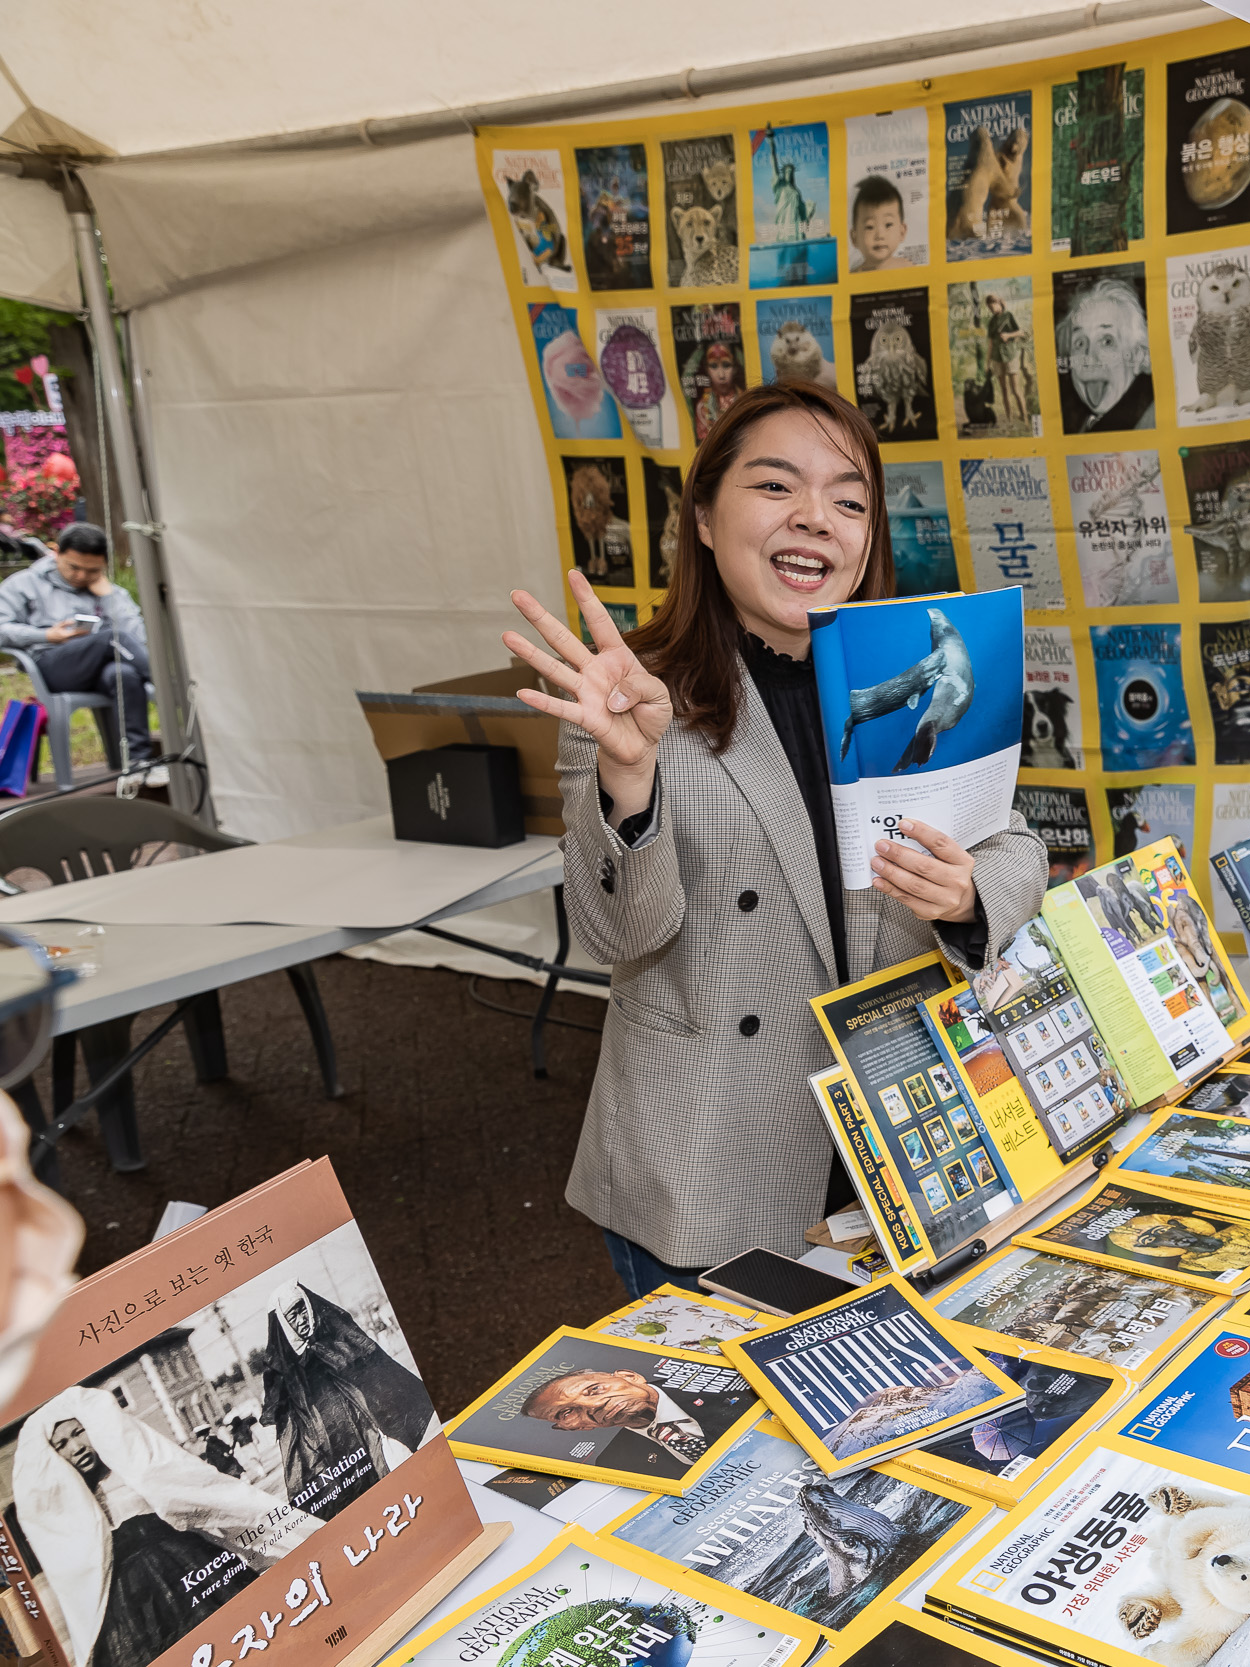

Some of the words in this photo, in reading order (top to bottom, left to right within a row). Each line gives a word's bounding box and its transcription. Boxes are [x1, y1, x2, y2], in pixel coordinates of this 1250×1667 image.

[1195, 70, 1236, 88] NATIONAL
[960, 100, 1017, 121] NATIONAL
[1181, 139, 1213, 163] 붉은
[1218, 133, 1250, 157] 행성
[1080, 166, 1121, 185] 레드우드
[966, 476, 1047, 500] GEOGRAPHIC
[977, 462, 1032, 485] NATIONAL
[1078, 516, 1127, 540] 유전자
[1131, 515, 1167, 537] 가위
[988, 522, 1038, 579] 물
[1053, 671, 1070, 683] 지능
[1018, 790, 1072, 806] NATIONAL
[1123, 791, 1181, 806] NATIONAL
[845, 1006, 885, 1030] SPECIAL
[881, 995, 917, 1016] EDITION
[913, 991, 925, 1003] 12
[856, 994, 887, 1011] NATIONAL
[884, 981, 921, 1000] GEOGRAPHIC
[832, 1089, 844, 1099] 3
[837, 1101, 856, 1129] PART
[973, 1118, 988, 1135] 20
[989, 1099, 1026, 1130] 내셔널
[850, 1129, 876, 1174] EDITION
[1001, 1122, 1038, 1153] 베스트
[1148, 1130, 1182, 1156] NATIONAL
[1153, 1127, 1198, 1162] GEOGRAPHIC
[870, 1173, 896, 1222] SPECIAL
[1037, 1211, 1098, 1240] 투탕카멘의
[1088, 1188, 1125, 1212] 보물들
[891, 1221, 908, 1250] KIDS
[1076, 1208, 1125, 1234] NATIONAL
[1081, 1206, 1144, 1240] GEOGRAPHIC
[76, 1289, 167, 1348] 사진으로
[172, 1263, 209, 1299] 보는
[213, 1247, 234, 1273] 옛
[238, 1224, 274, 1258] 한국
[967, 1266, 1020, 1299] NATIONAL
[972, 1265, 1039, 1308] GEOGRAPHIC
[789, 1308, 864, 1341] NATIONAL
[799, 1315, 826, 1328] PREPARED
[850, 1289, 886, 1307] CORONAVIRUS
[1110, 1296, 1180, 1346] 세렝게티
[785, 1310, 878, 1351] GEOGRAPHIC
[653, 1359, 683, 1379] LAST
[662, 1362, 700, 1388] VOICES
[682, 1366, 721, 1393] WORLD
[702, 1376, 734, 1393] WAR
[721, 1369, 739, 1377] II
[766, 1310, 963, 1431] EVEREST
[493, 1364, 558, 1412] NATIONAL
[893, 1420, 906, 1430] TO
[907, 1415, 922, 1426] THE
[922, 1408, 939, 1420] ROOF
[894, 1427, 906, 1436] OF
[906, 1421, 922, 1432] THE
[921, 1411, 948, 1427] WORLD
[897, 1407, 930, 1423] JOURNEY
[1140, 1394, 1179, 1424] NATIONAL
[1151, 1389, 1198, 1428] GEOGRAPHIC
[667, 1462, 742, 1513] NATIONAL
[672, 1460, 762, 1526] GEOGRAPHIC
[695, 1499, 747, 1537] Secrets
[745, 1485, 757, 1501] of
[758, 1471, 783, 1490] the
[180, 1550, 236, 1593] Korea,
[235, 1523, 266, 1548] The
[266, 1481, 320, 1527] Hermit
[318, 1447, 367, 1487] Nation
[704, 1505, 716, 1515] THE
[191, 1596, 200, 1607] A
[201, 1583, 222, 1599] rare
[223, 1553, 257, 1585] glimpse
[258, 1541, 269, 1555] of
[269, 1530, 283, 1546] old
[284, 1513, 310, 1534] Korea
[310, 1486, 342, 1514] through
[342, 1474, 355, 1489] the
[356, 1462, 373, 1480] lens
[342, 1491, 424, 1567] 나라
[762, 1535, 782, 1549] LIKE
[747, 1539, 768, 1553] AND
[989, 1533, 1035, 1570] NATIONAL
[1001, 1527, 1055, 1575] GEOGRAPHIC
[1021, 1491, 1151, 1605] 야생동물
[1062, 1593, 1090, 1617] 가장
[1084, 1562, 1121, 1593] 위대한
[1114, 1534, 1149, 1563] 사진들
[457, 1584, 551, 1647] NATIONAL
[459, 1584, 572, 1663] GEOGRAPHIC
[573, 1608, 634, 1650] 인구
[608, 1623, 674, 1667] 시대
